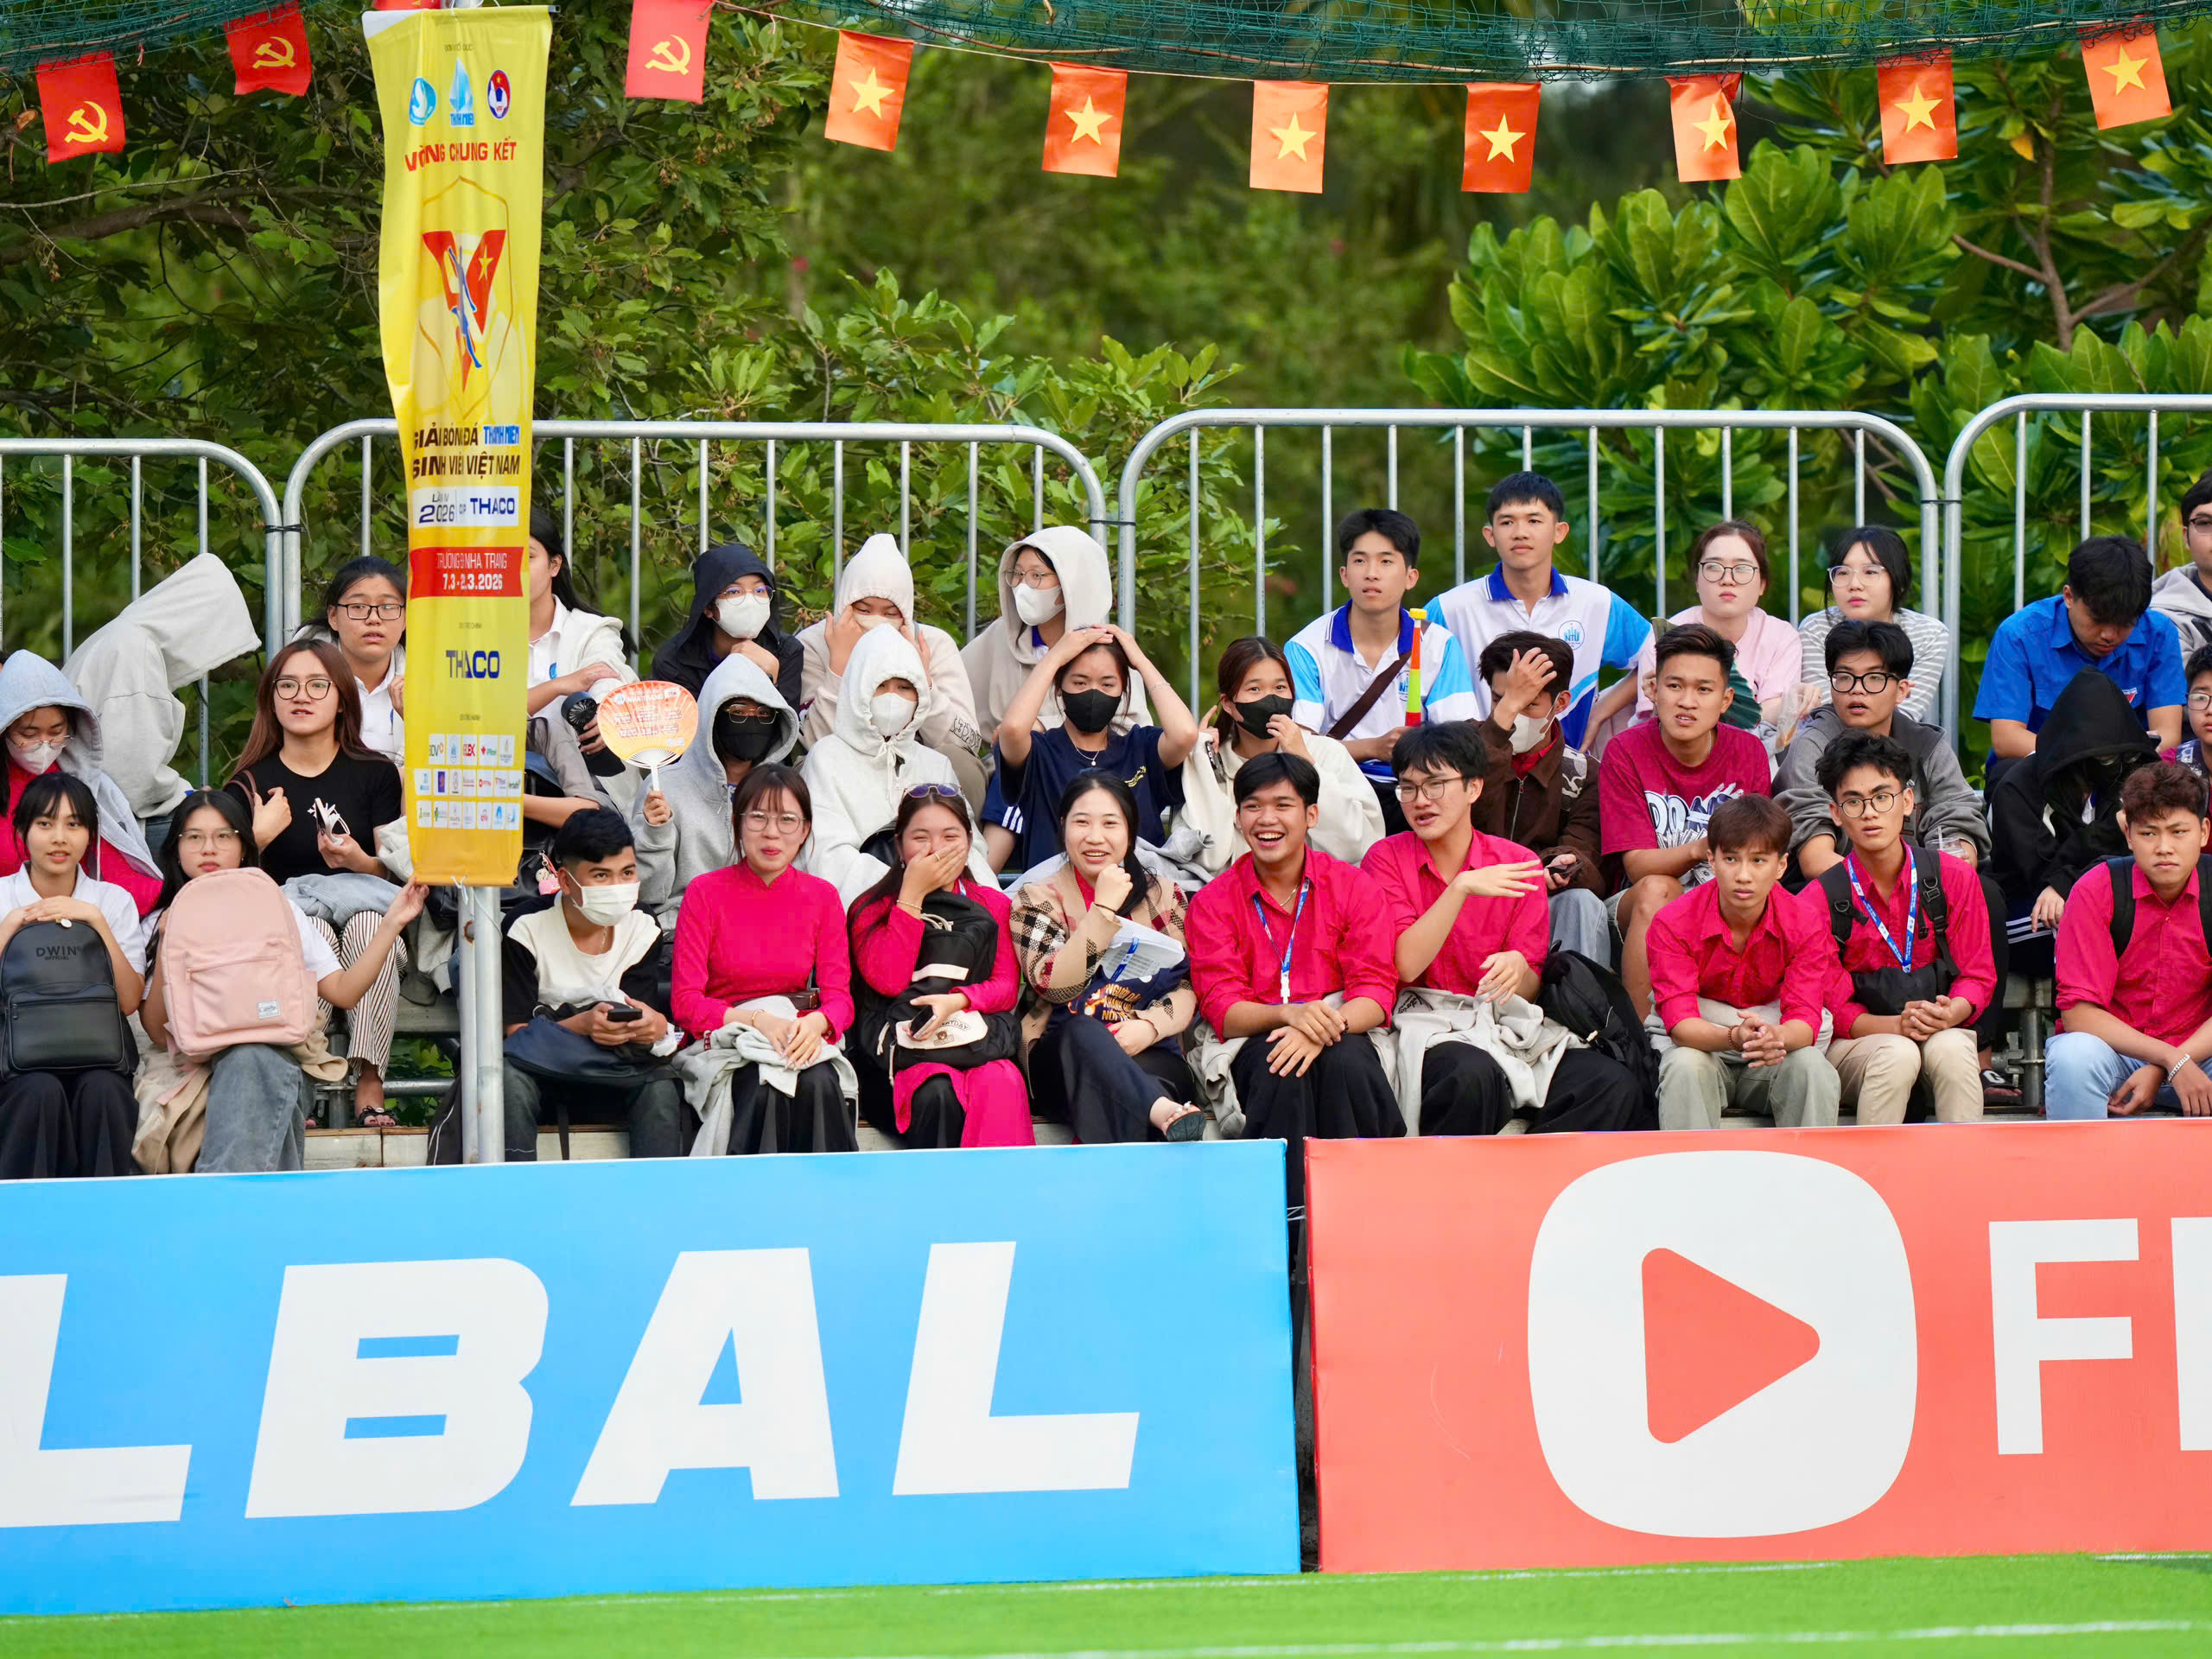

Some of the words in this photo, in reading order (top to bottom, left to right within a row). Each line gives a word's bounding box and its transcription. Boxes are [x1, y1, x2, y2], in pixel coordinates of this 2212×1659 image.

[449, 142, 488, 162] CHUNG
[493, 136, 517, 161] KẾT
[413, 455, 446, 480] SINH
[449, 451, 464, 475] VIÊ
[467, 451, 494, 480] VIỆT
[496, 455, 520, 475] NAM
[419, 504, 455, 524] 2026
[470, 498, 516, 515] THACO
[465, 553, 482, 569] NHA
[484, 552, 507, 569] TRANG
[446, 650, 500, 679] THACO
[36, 945, 77, 957] DWIN
[1988, 1216, 2212, 1455] F
